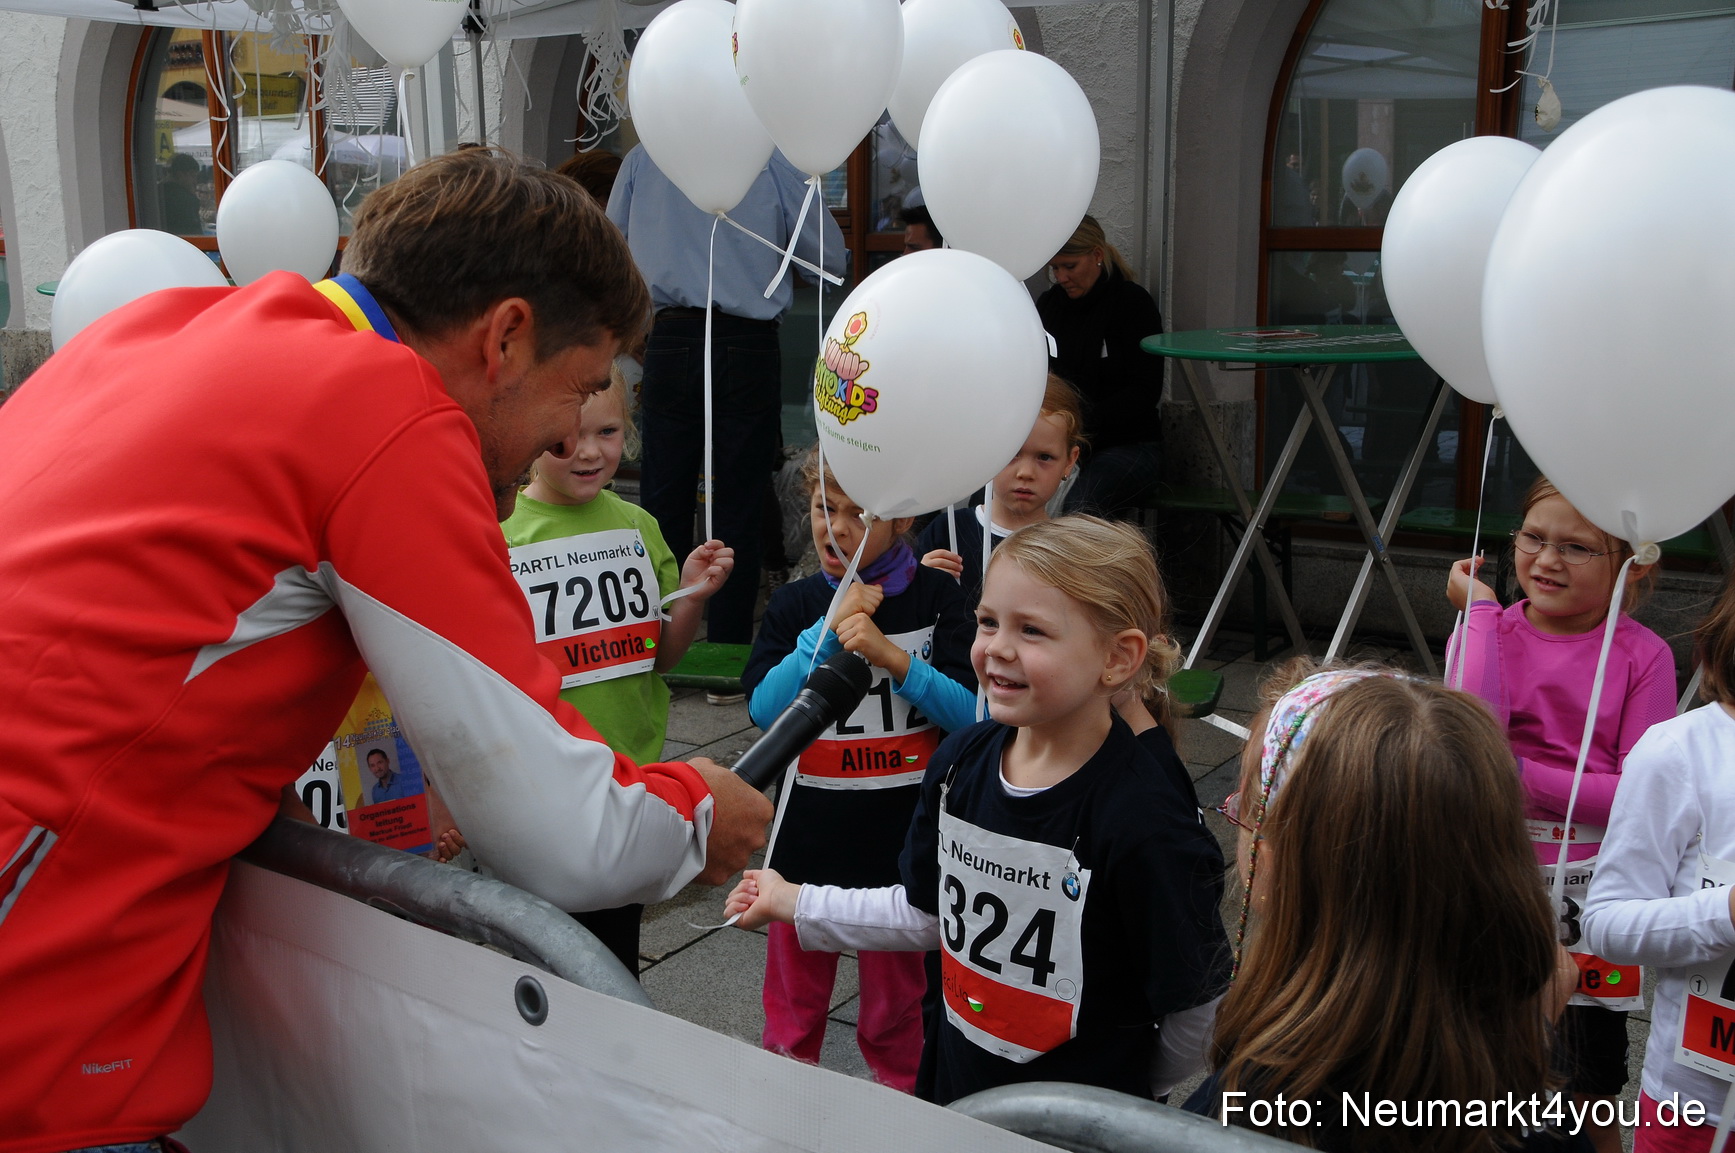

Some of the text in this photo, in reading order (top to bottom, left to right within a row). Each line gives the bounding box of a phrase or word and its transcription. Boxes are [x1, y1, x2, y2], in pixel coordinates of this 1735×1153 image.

[846, 437, 881, 453] steigen
[510, 545, 632, 576] PARTL Neumarkt
[529, 567, 650, 636] 7203
[564, 633, 645, 668] Victoria
[312, 758, 338, 772] Ne
[841, 747, 902, 771] Alina
[359, 803, 416, 822] Organisations
[375, 817, 404, 828] leitung
[951, 839, 1051, 891] Neumarkt
[81, 1058, 133, 1075] NikeFIT
